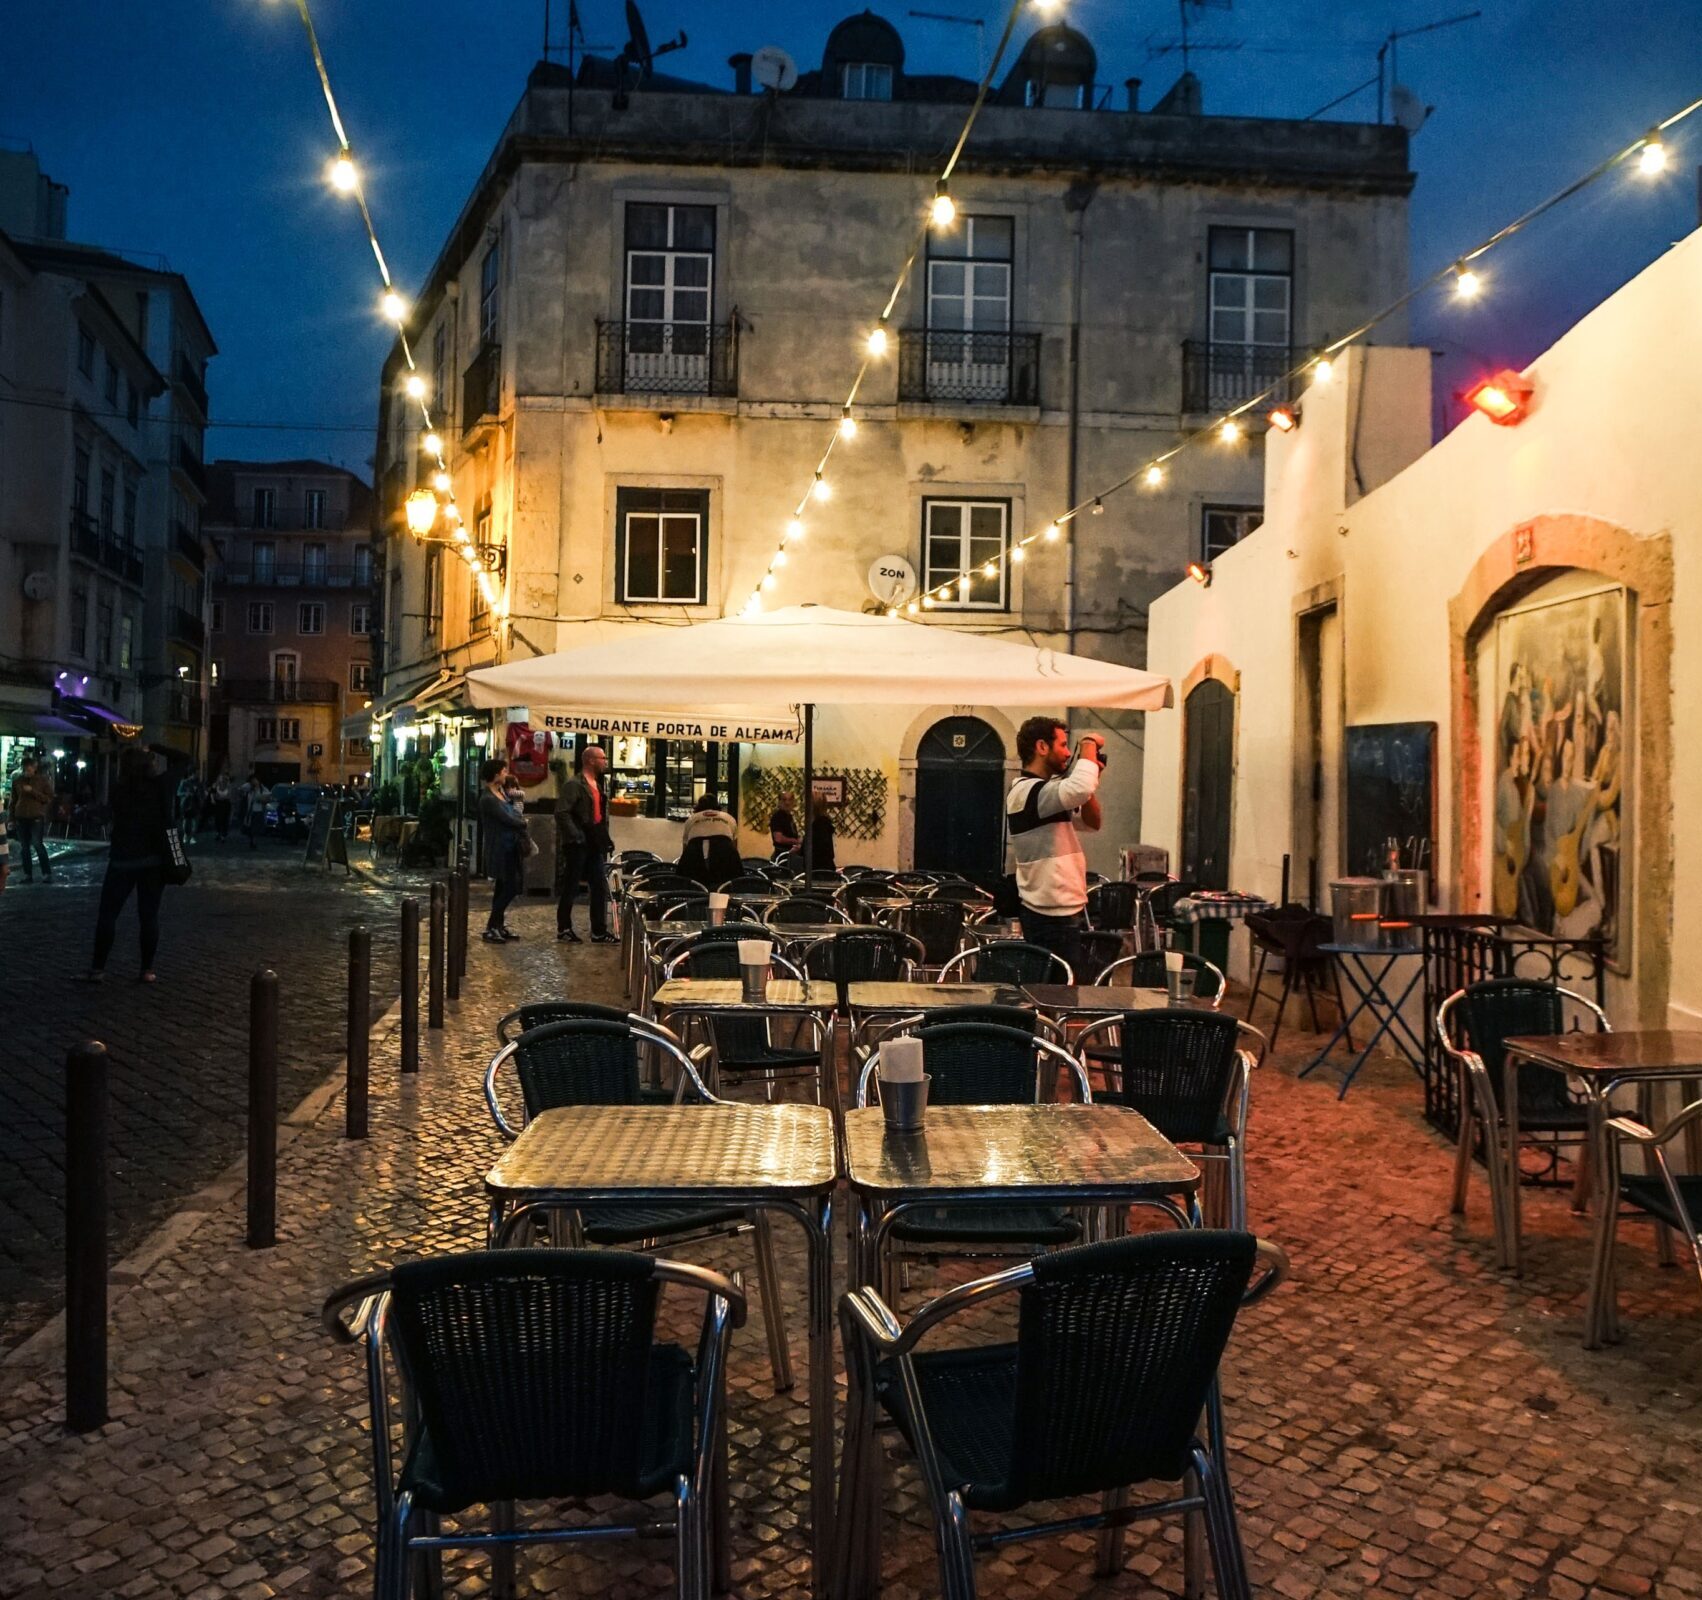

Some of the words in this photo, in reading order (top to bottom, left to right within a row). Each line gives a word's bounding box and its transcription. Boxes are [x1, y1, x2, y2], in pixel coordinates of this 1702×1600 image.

[880, 567, 905, 579] ZON
[545, 715, 650, 734] RESTAURANTE
[656, 722, 703, 736] PORTA
[710, 725, 727, 737] DE
[735, 727, 794, 740] ALFAMA
